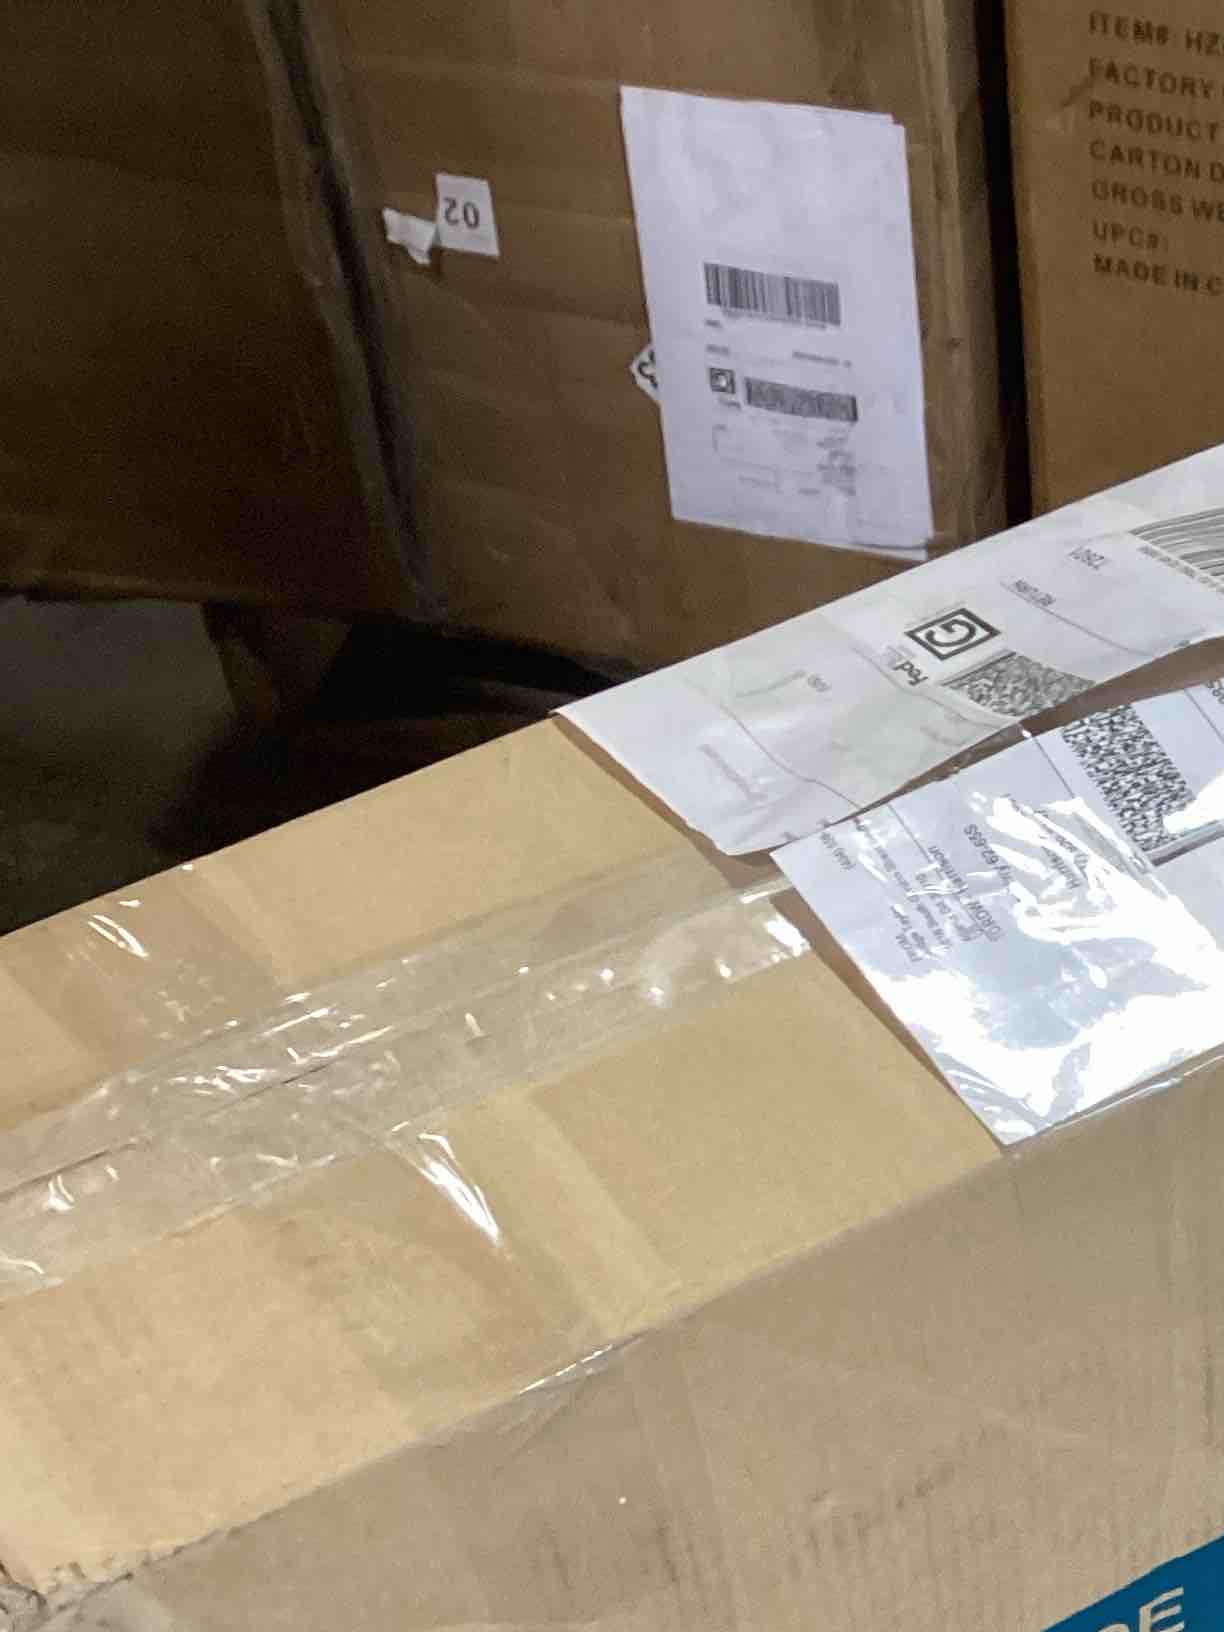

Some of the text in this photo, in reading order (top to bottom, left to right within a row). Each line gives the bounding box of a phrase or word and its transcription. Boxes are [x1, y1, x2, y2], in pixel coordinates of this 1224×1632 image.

[1089, 56, 1213, 100] FACTORY
[1089, 100, 1219, 143] PRODUCT
[1089, 140, 1200, 181] CARTON
[1092, 180, 1183, 215] GROSS
[1093, 253, 1166, 286] MADE
[1174, 269, 1199, 292] IN
